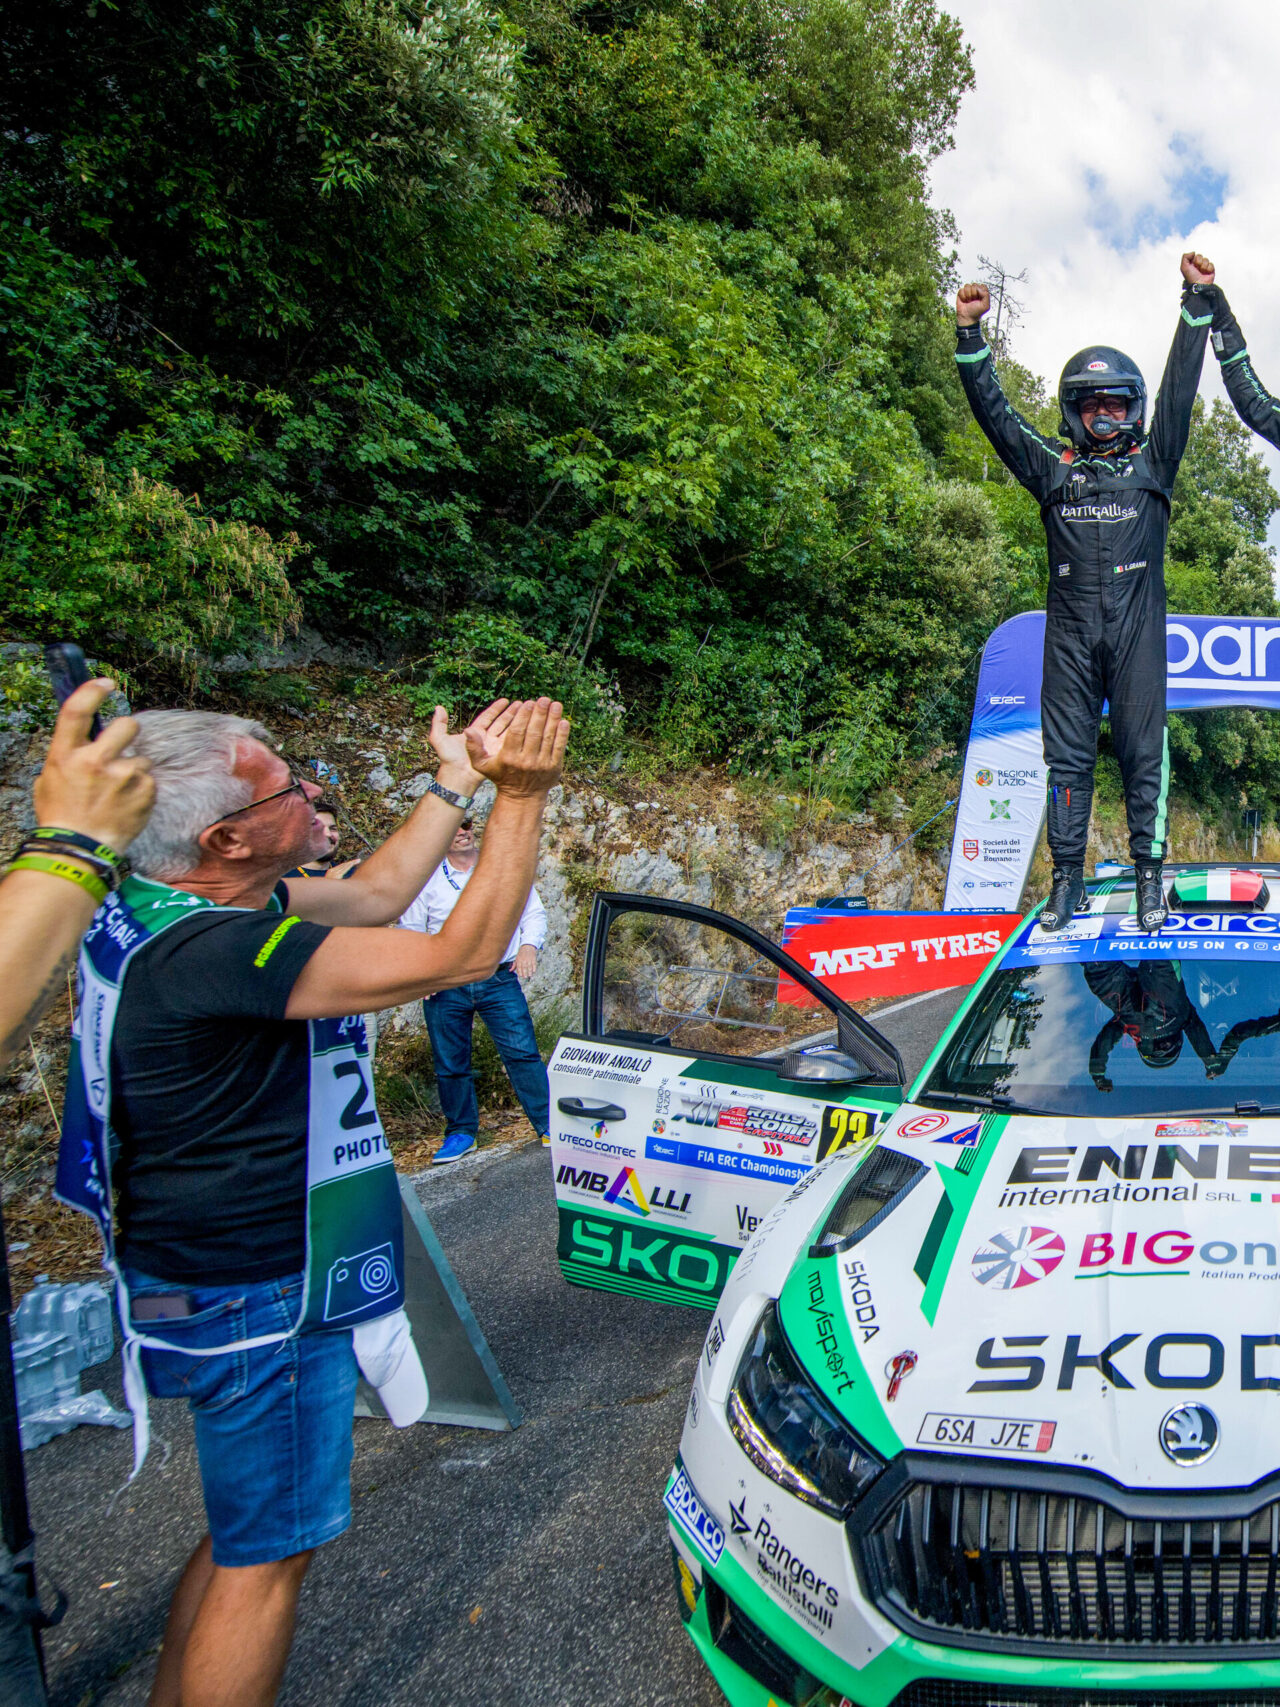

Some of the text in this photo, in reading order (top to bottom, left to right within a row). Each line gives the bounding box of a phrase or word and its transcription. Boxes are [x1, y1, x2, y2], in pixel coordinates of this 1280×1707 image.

[990, 696, 1025, 705] ERC
[997, 770, 1038, 778] REGIONE
[1029, 945, 1081, 956] ERC
[1032, 933, 1096, 943] SPORT
[1109, 941, 1225, 951] FOLLOW US ON
[810, 930, 1002, 977] MRF TYRES
[560, 1047, 652, 1073] GIOVANNI ANDALÒ
[553, 1063, 642, 1085] consulente patrimoniale
[656, 1077, 669, 1114] REGIONE
[663, 1089, 671, 1115] LAZIO
[746, 1106, 807, 1123] RALLY
[743, 1127, 812, 1146] CAPITALE
[744, 1117, 818, 1139] ROMA
[825, 1108, 868, 1158] 23
[559, 1133, 637, 1158] UTECO CONTEC
[697, 1150, 809, 1180] FIA ERC Championshi
[556, 1164, 692, 1217] IMBALLI
[998, 1182, 1242, 1208] international SRL
[569, 1219, 739, 1292] SKO
[1201, 1269, 1246, 1281] Italian
[845, 1261, 880, 1344] SKODA
[934, 1418, 1034, 1448] 6SA J7E
[672, 1475, 724, 1551] sparco
[754, 1518, 839, 1608] Rangers
[757, 1552, 834, 1629] Battistolli
